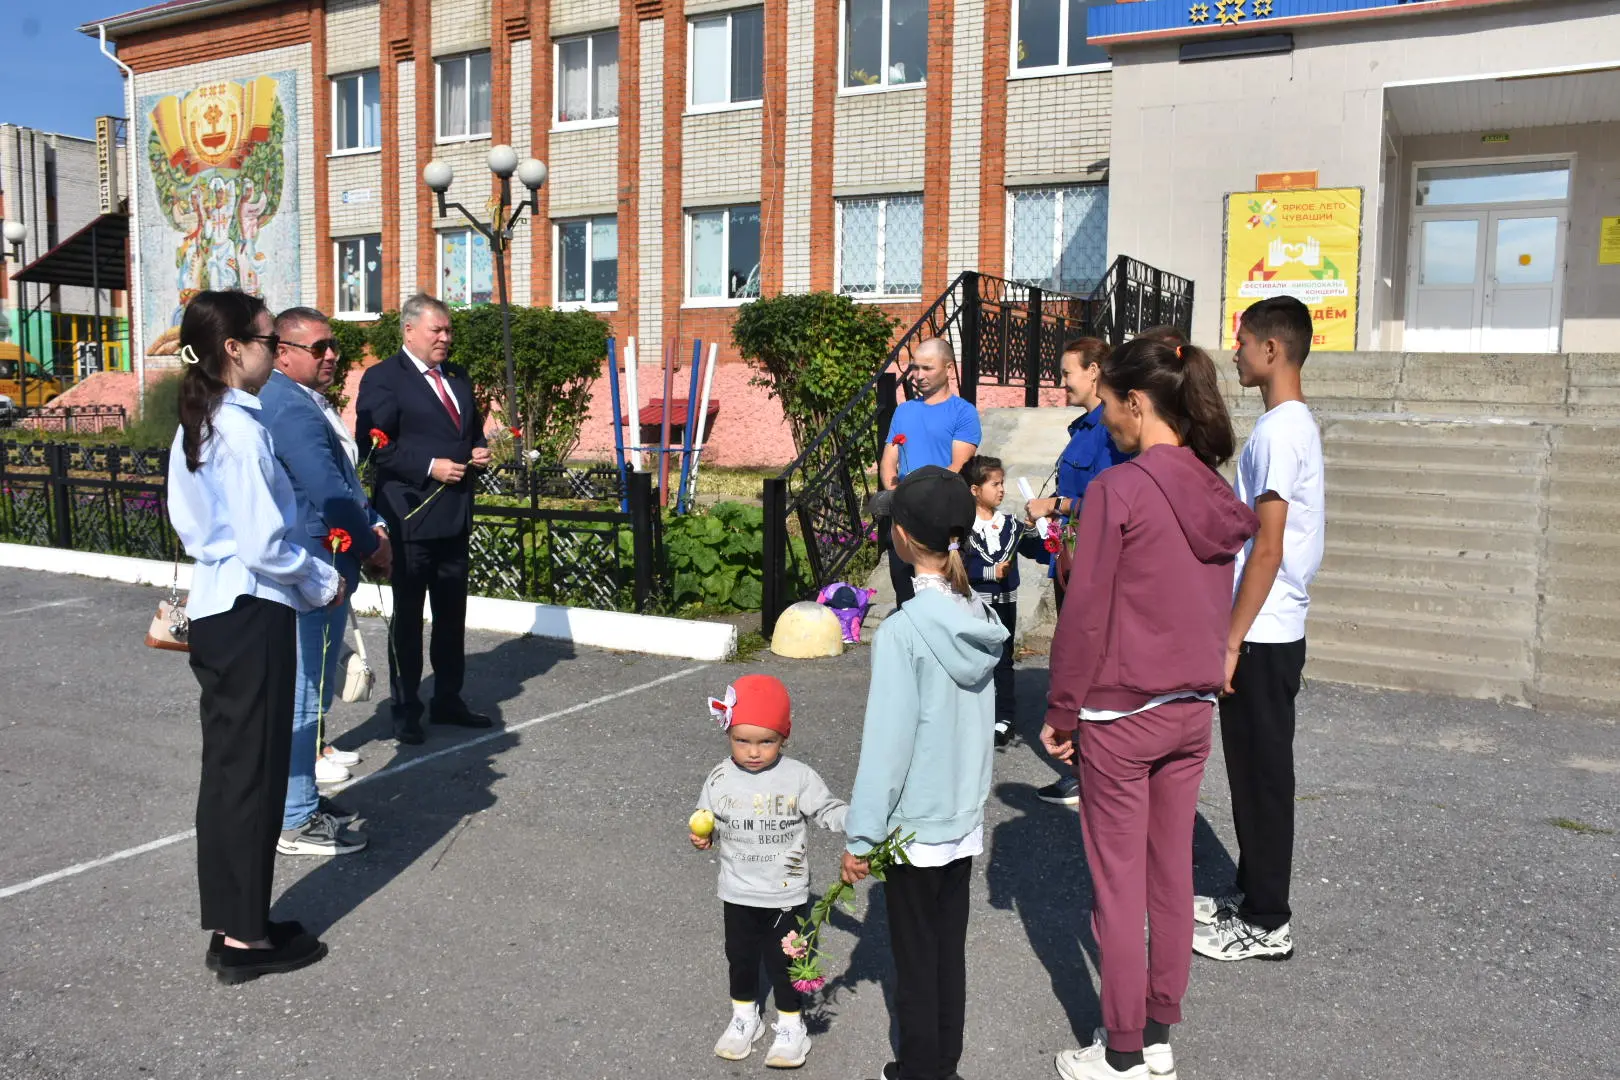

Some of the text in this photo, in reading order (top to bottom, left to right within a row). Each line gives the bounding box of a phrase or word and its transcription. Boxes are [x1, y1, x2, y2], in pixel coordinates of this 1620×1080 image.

[1282, 202, 1346, 211] ЯРКОЕ ЛЕТО
[1282, 213, 1333, 221] ЧУВАШИИ
[1309, 306, 1347, 319] ДЁМ
[743, 819, 754, 830] IN
[760, 819, 777, 831] THE
[758, 831, 794, 845] BEGINS
[746, 854, 760, 862] GET
